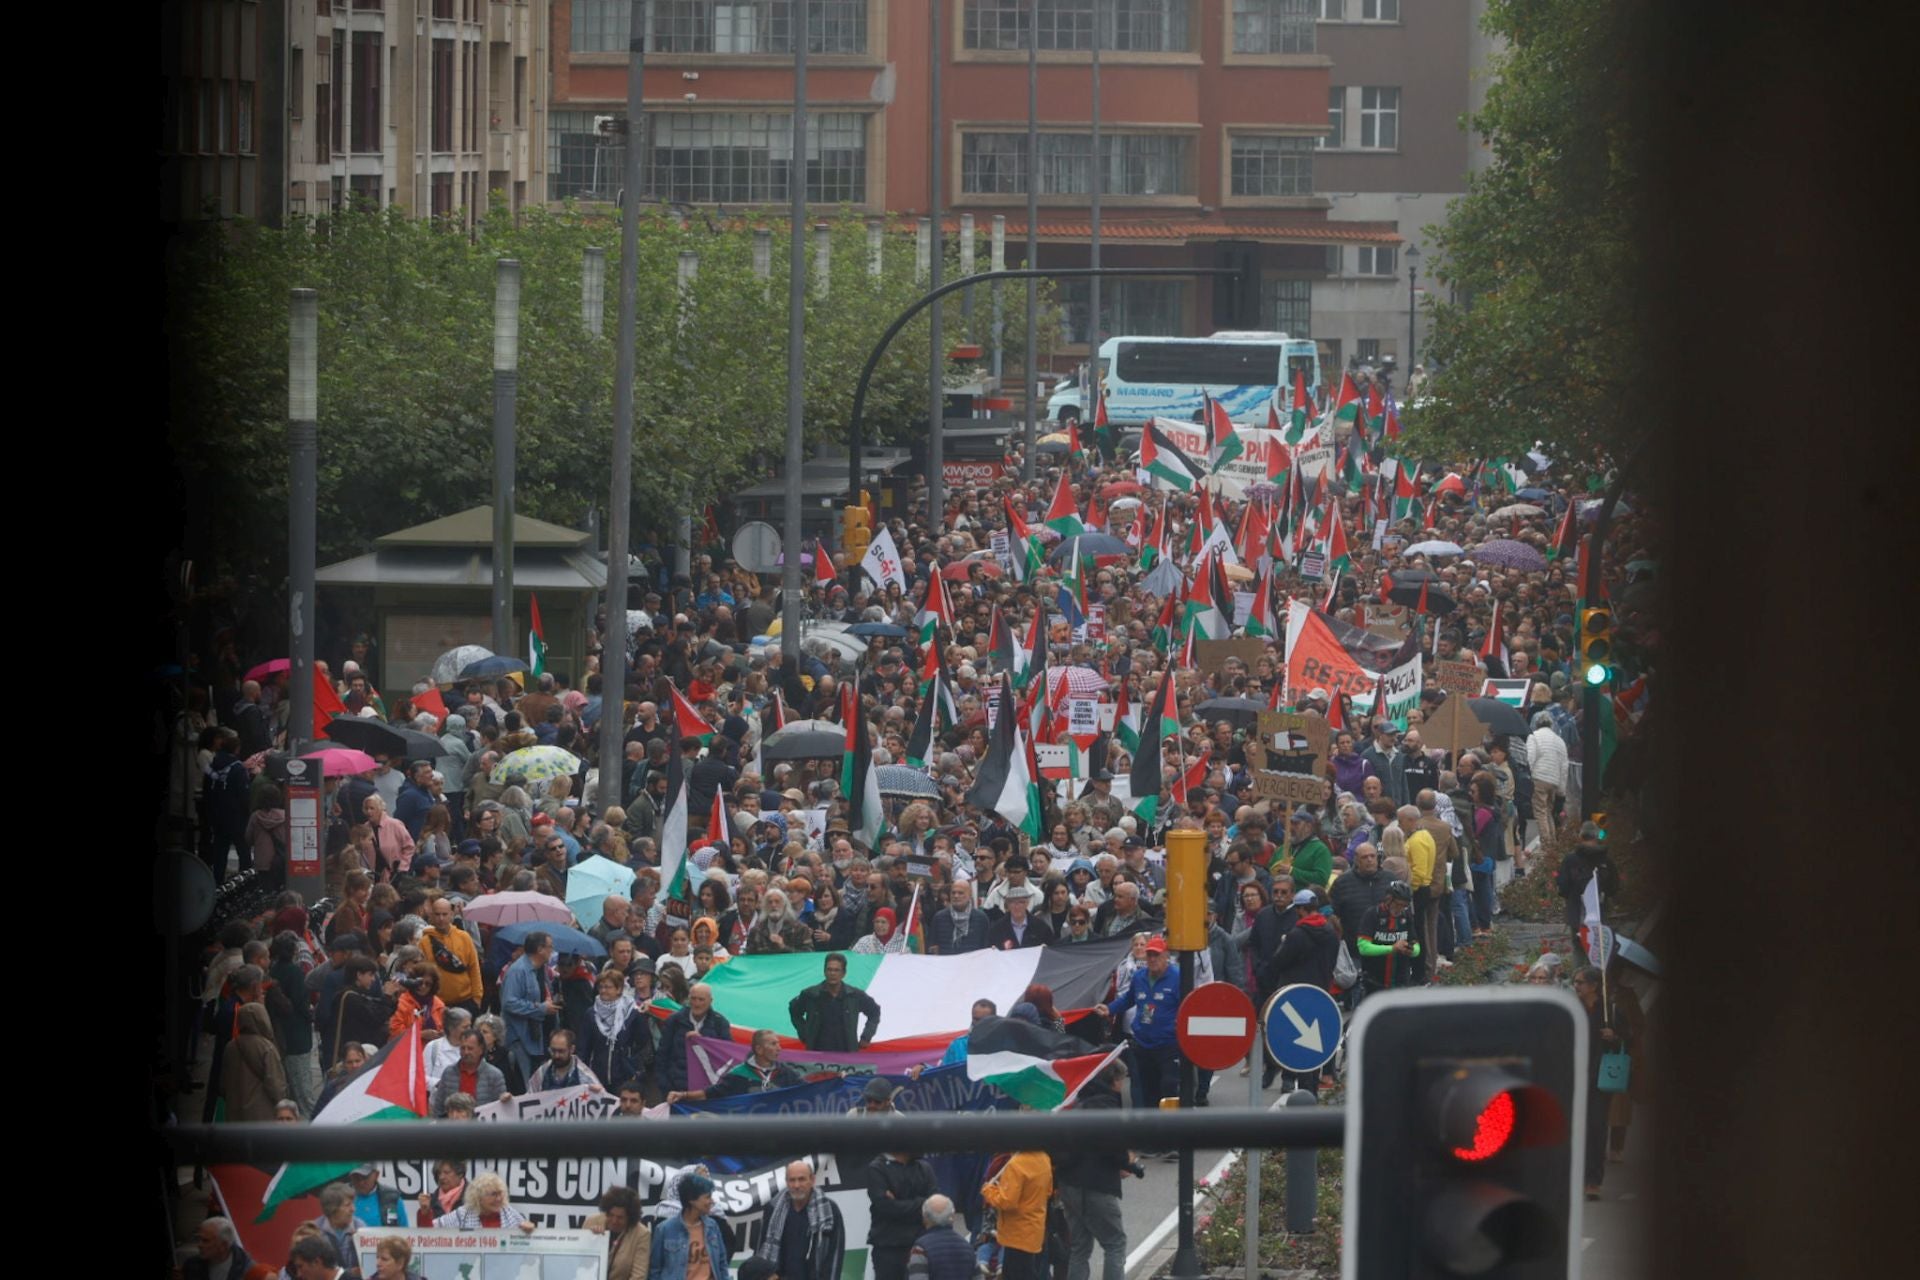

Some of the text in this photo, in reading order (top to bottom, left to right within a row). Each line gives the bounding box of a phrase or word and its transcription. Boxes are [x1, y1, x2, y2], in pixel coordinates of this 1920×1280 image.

[942, 465, 993, 477] KIWOKO
[556, 1156, 628, 1200] CON
[454, 1237, 477, 1248] desde
